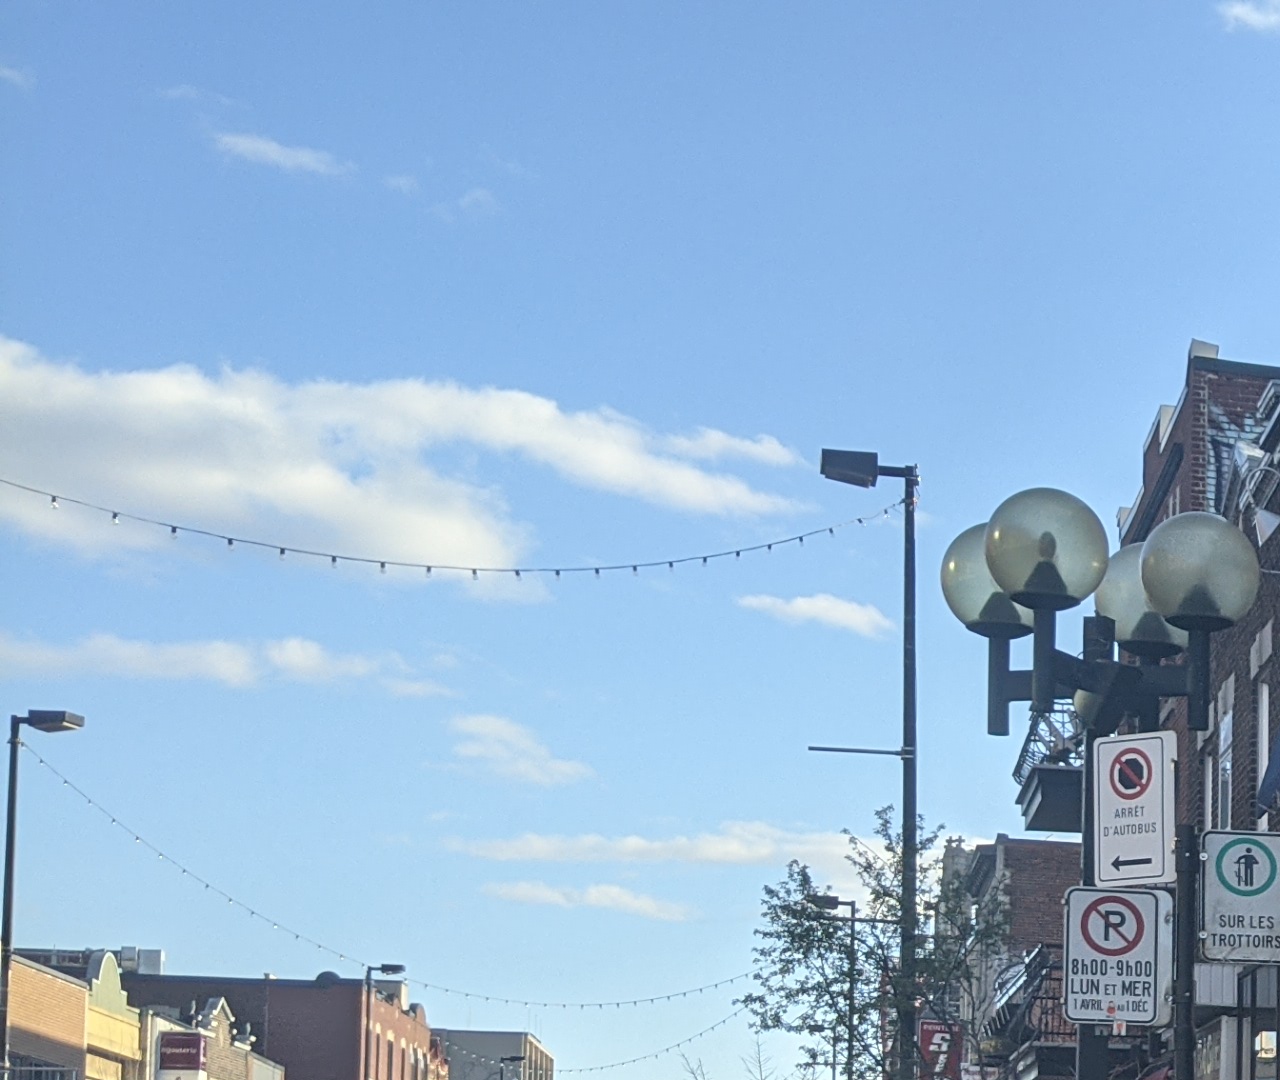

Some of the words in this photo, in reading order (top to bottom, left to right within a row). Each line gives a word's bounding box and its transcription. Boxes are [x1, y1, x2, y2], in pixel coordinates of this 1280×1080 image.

[1114, 805, 1146, 820] ARRÊT
[1103, 822, 1158, 838] D'AUTOBUS
[1219, 914, 1246, 929] SUR
[1249, 915, 1275, 930] LES
[1071, 958, 1153, 978] 8h00-9h00
[1071, 978, 1100, 995] LUN
[1104, 984, 1118, 996] ET
[1121, 980, 1152, 998] MER
[1080, 998, 1104, 1011] AVRIL
[1131, 999, 1149, 1013] DÉC
